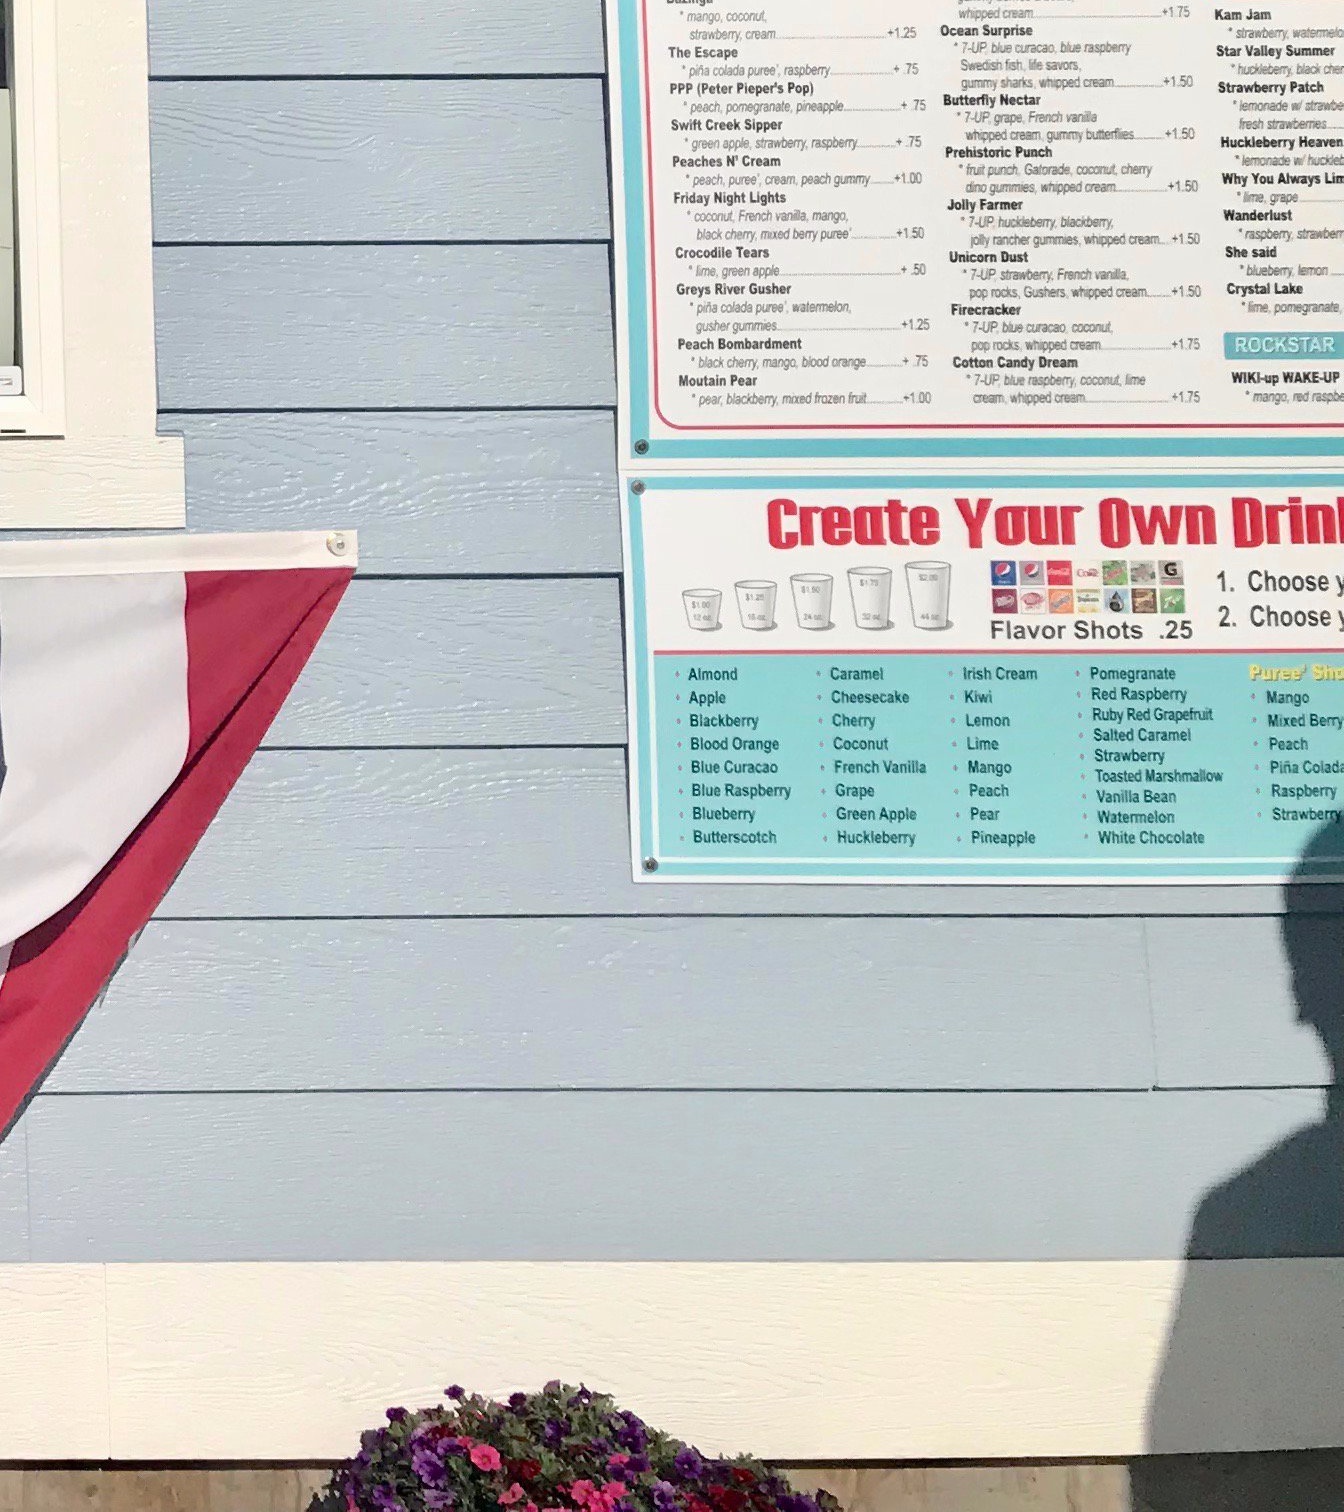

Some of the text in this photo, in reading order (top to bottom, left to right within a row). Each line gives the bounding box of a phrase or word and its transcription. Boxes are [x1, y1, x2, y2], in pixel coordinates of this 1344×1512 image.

[940, 24, 1032, 39] Ocean Surprise
[675, 246, 769, 258] Crocodile Tears
[949, 251, 1028, 263] Unicorn Dust
[951, 304, 1021, 315] Firecracker
[767, 498, 1217, 549] Create Your Own
[1217, 570, 1329, 592] 1. Choose
[991, 620, 1192, 639] Flavor Shots .25
[688, 667, 737, 680] Almond
[830, 667, 884, 680] Caramel
[1090, 667, 1176, 683] Pomegranate
[832, 690, 909, 704] Cheesecake
[964, 690, 992, 703] Kiwi
[690, 714, 759, 730] Blackberry
[693, 807, 755, 823] Blueberry
[1097, 810, 1174, 823] Watermelon
[972, 830, 1035, 847] Pineapple
